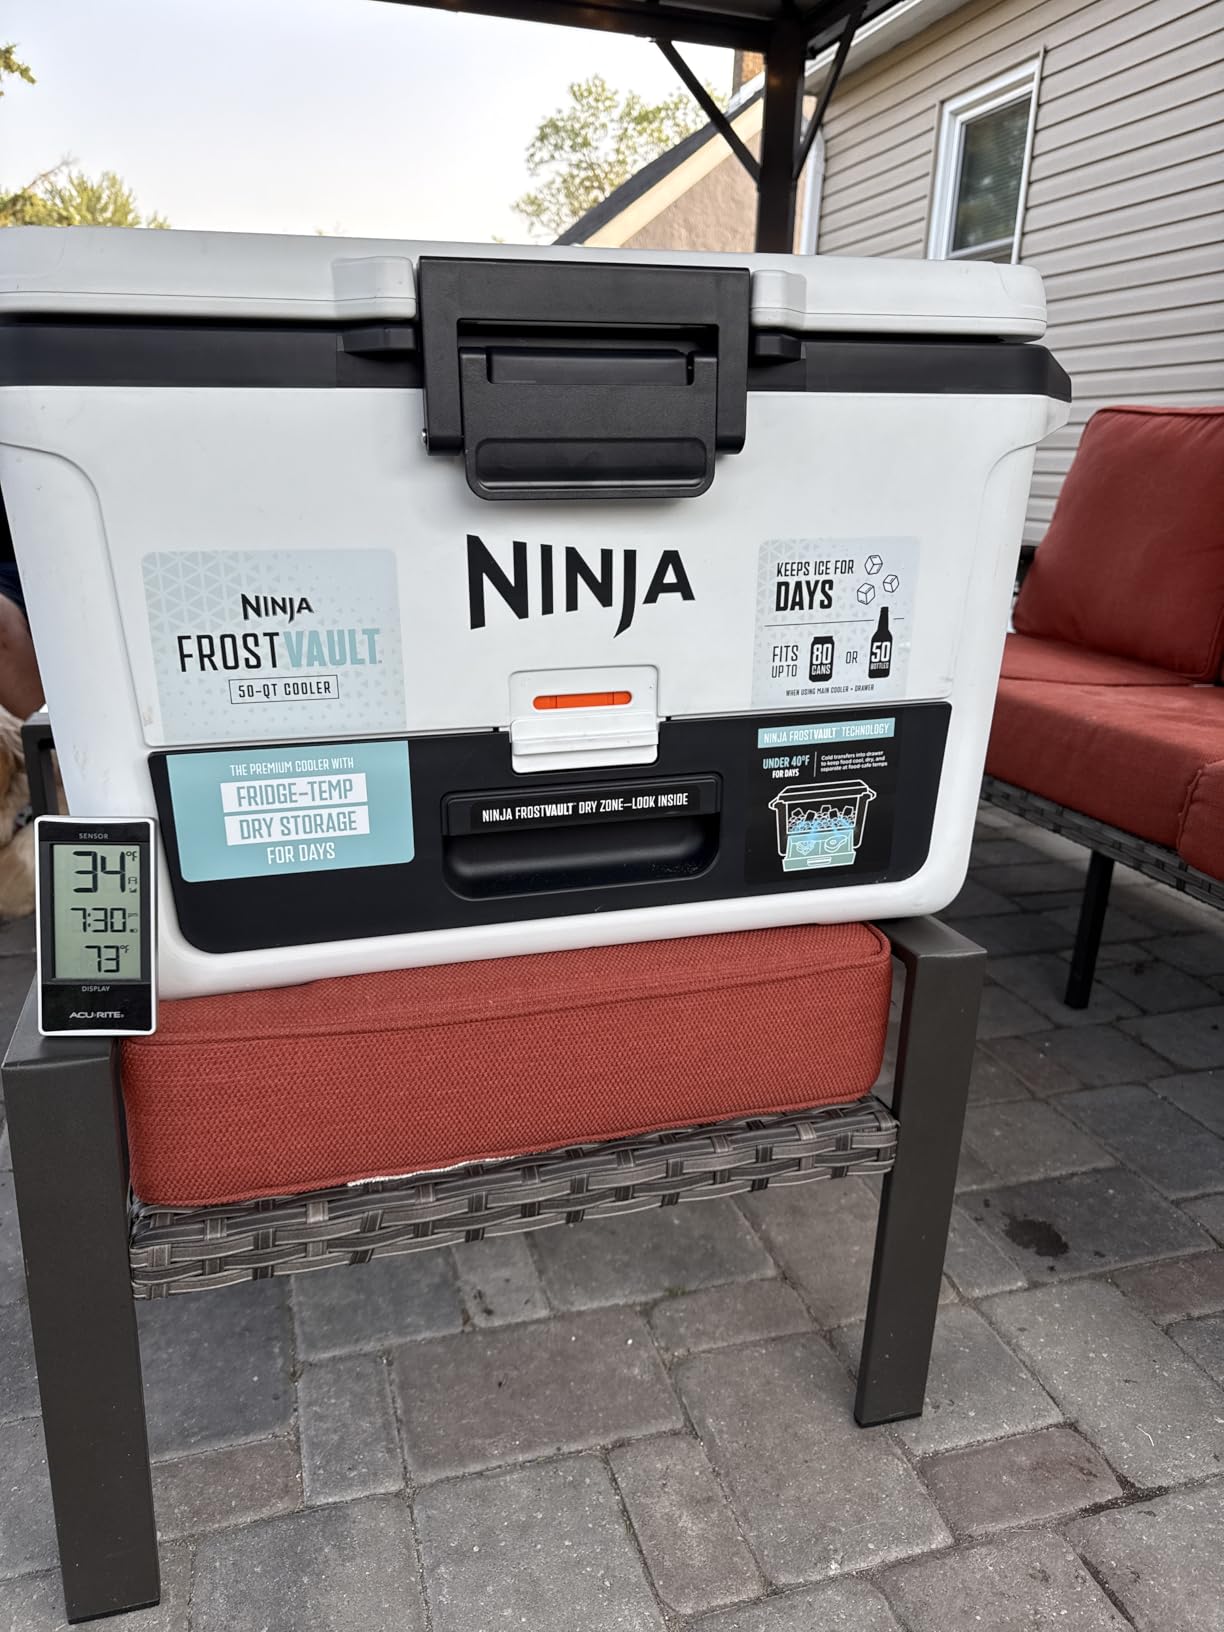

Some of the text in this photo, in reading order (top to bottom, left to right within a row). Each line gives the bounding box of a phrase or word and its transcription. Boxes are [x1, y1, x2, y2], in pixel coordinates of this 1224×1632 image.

[777, 559, 854, 577] KEEPS ICE FOR
[466, 534, 696, 639] NINJA
[775, 579, 834, 612] DAYS
[240, 593, 314, 624] NINJA
[772, 645, 799, 663] FITS
[812, 643, 832, 665] 80
[845, 651, 858, 664] OR
[871, 641, 891, 662] 50
[771, 664, 798, 678] UP TO
[811, 664, 831, 676] CANS
[238, 681, 332, 699] 50-QT COOLER
[801, 688, 816, 696] USING
[764, 733, 787, 744] NINJA
[842, 723, 889, 737] TECHNOLOGY
[229, 757, 354, 777] THE PREMIUM COOLER WITH
[763, 755, 810, 769] UNDER 40°F
[772, 768, 799, 779] FOR DAYS
[236, 778, 353, 807] FRIDGE-TEMP
[482, 808, 513, 823] NINJA
[578, 800, 598, 814] DRY
[657, 793, 689, 807] INSIDE
[239, 810, 358, 840] DRY STORAGE
[266, 842, 336, 865] FOR DAYS
[70, 907, 127, 933] 7:30
